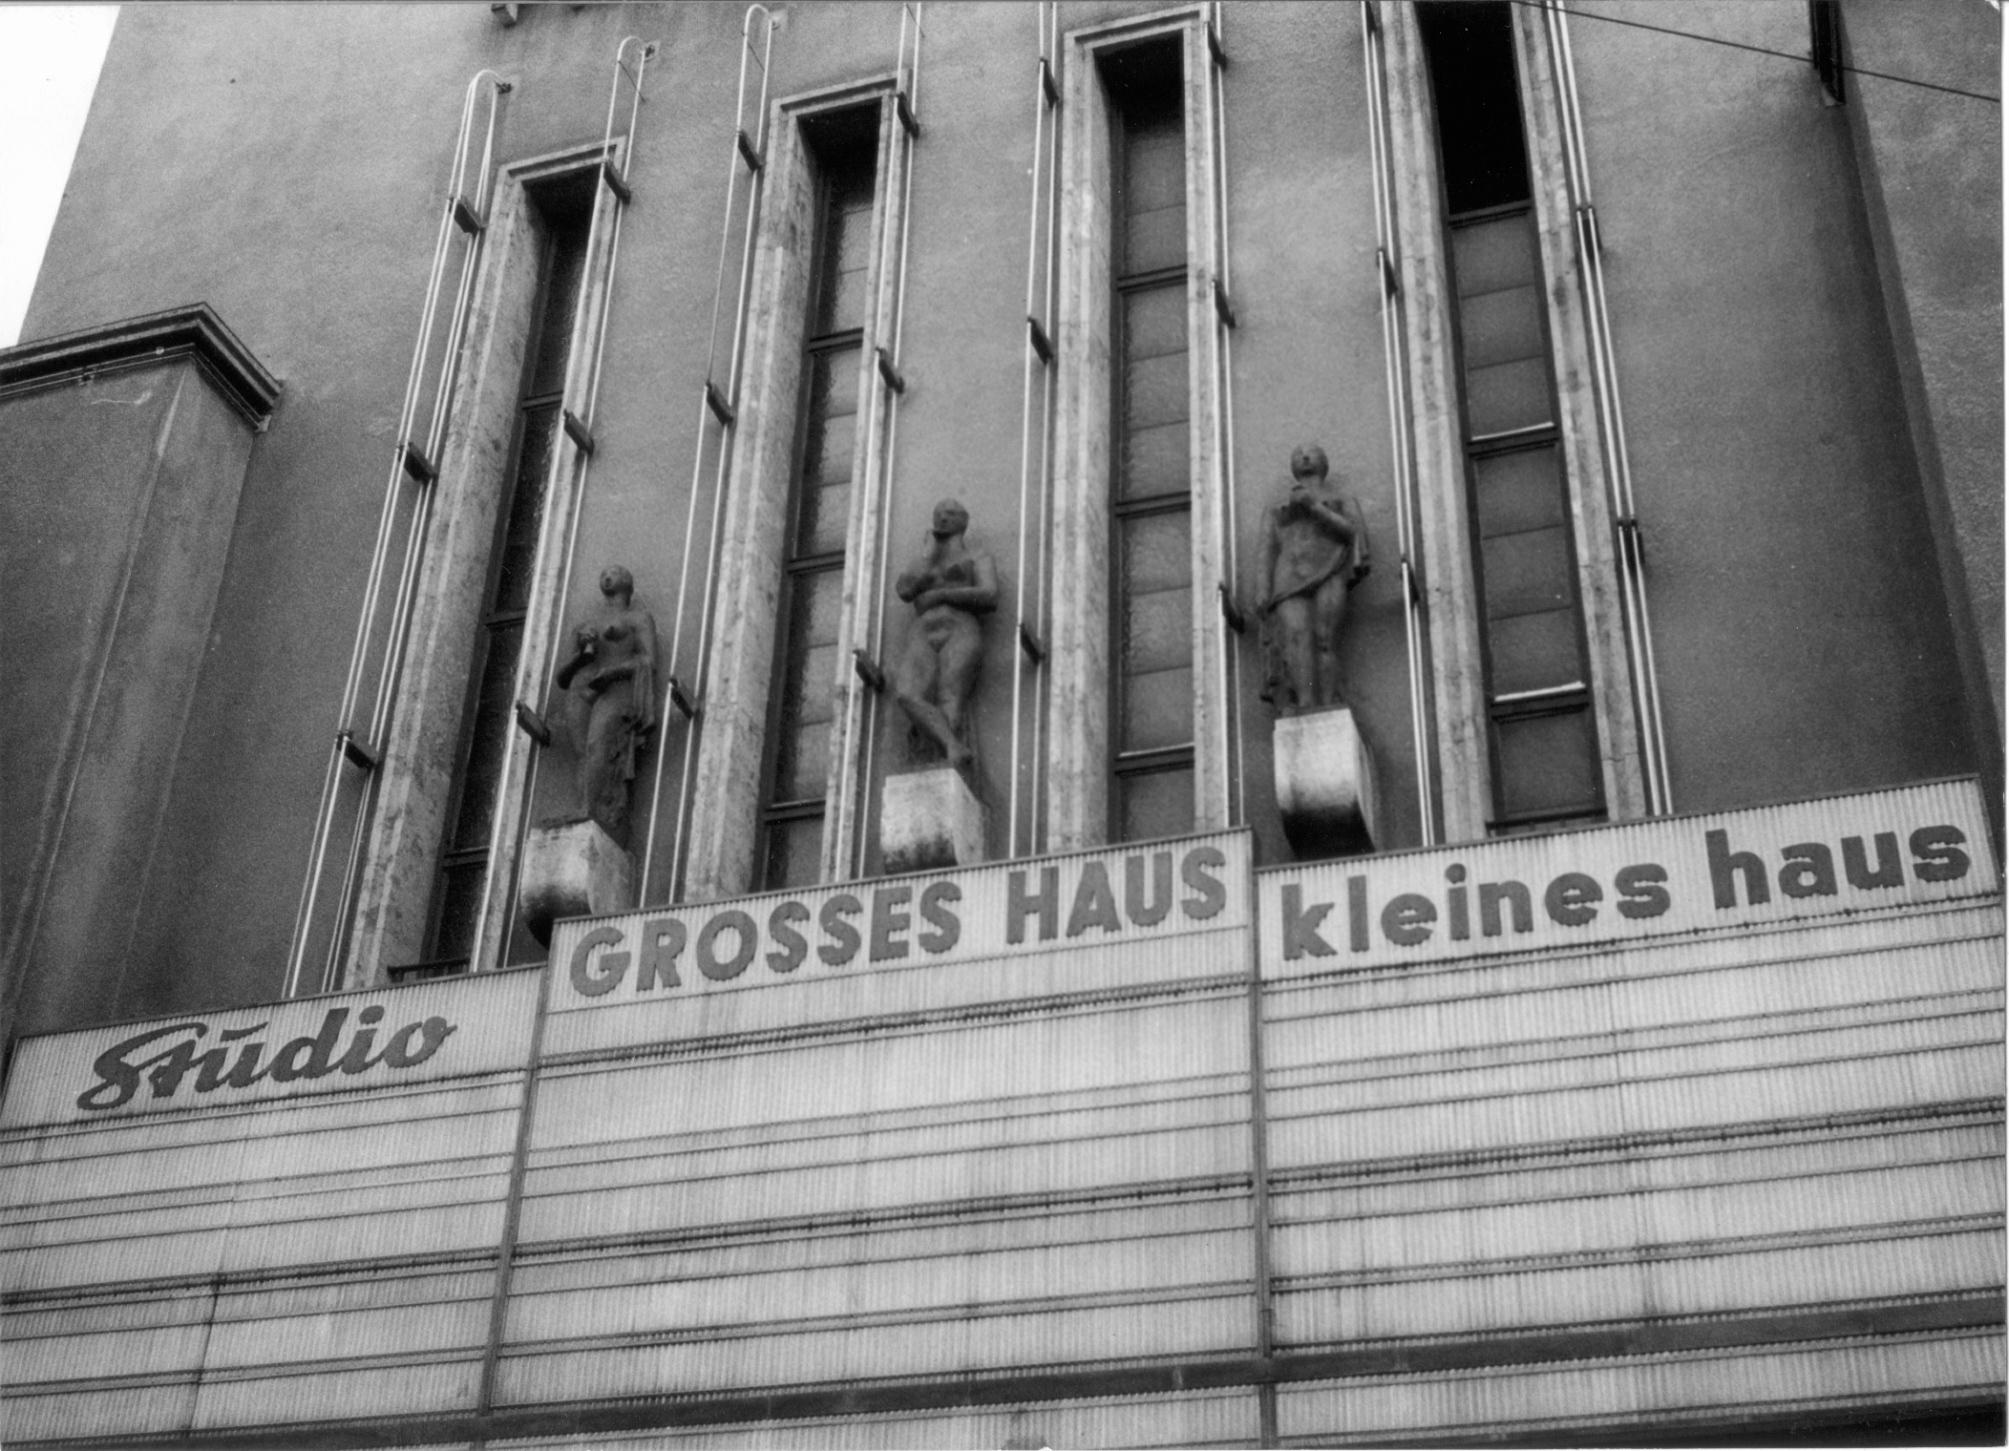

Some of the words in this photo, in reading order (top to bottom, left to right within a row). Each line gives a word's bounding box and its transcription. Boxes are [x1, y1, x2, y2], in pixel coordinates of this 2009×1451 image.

[569, 881, 963, 998] GROSSES
[1005, 846, 1227, 945] HAUS
[1281, 862, 1671, 961] kleines
[1704, 824, 1972, 910] haus
[76, 1005, 458, 1111] Studio
